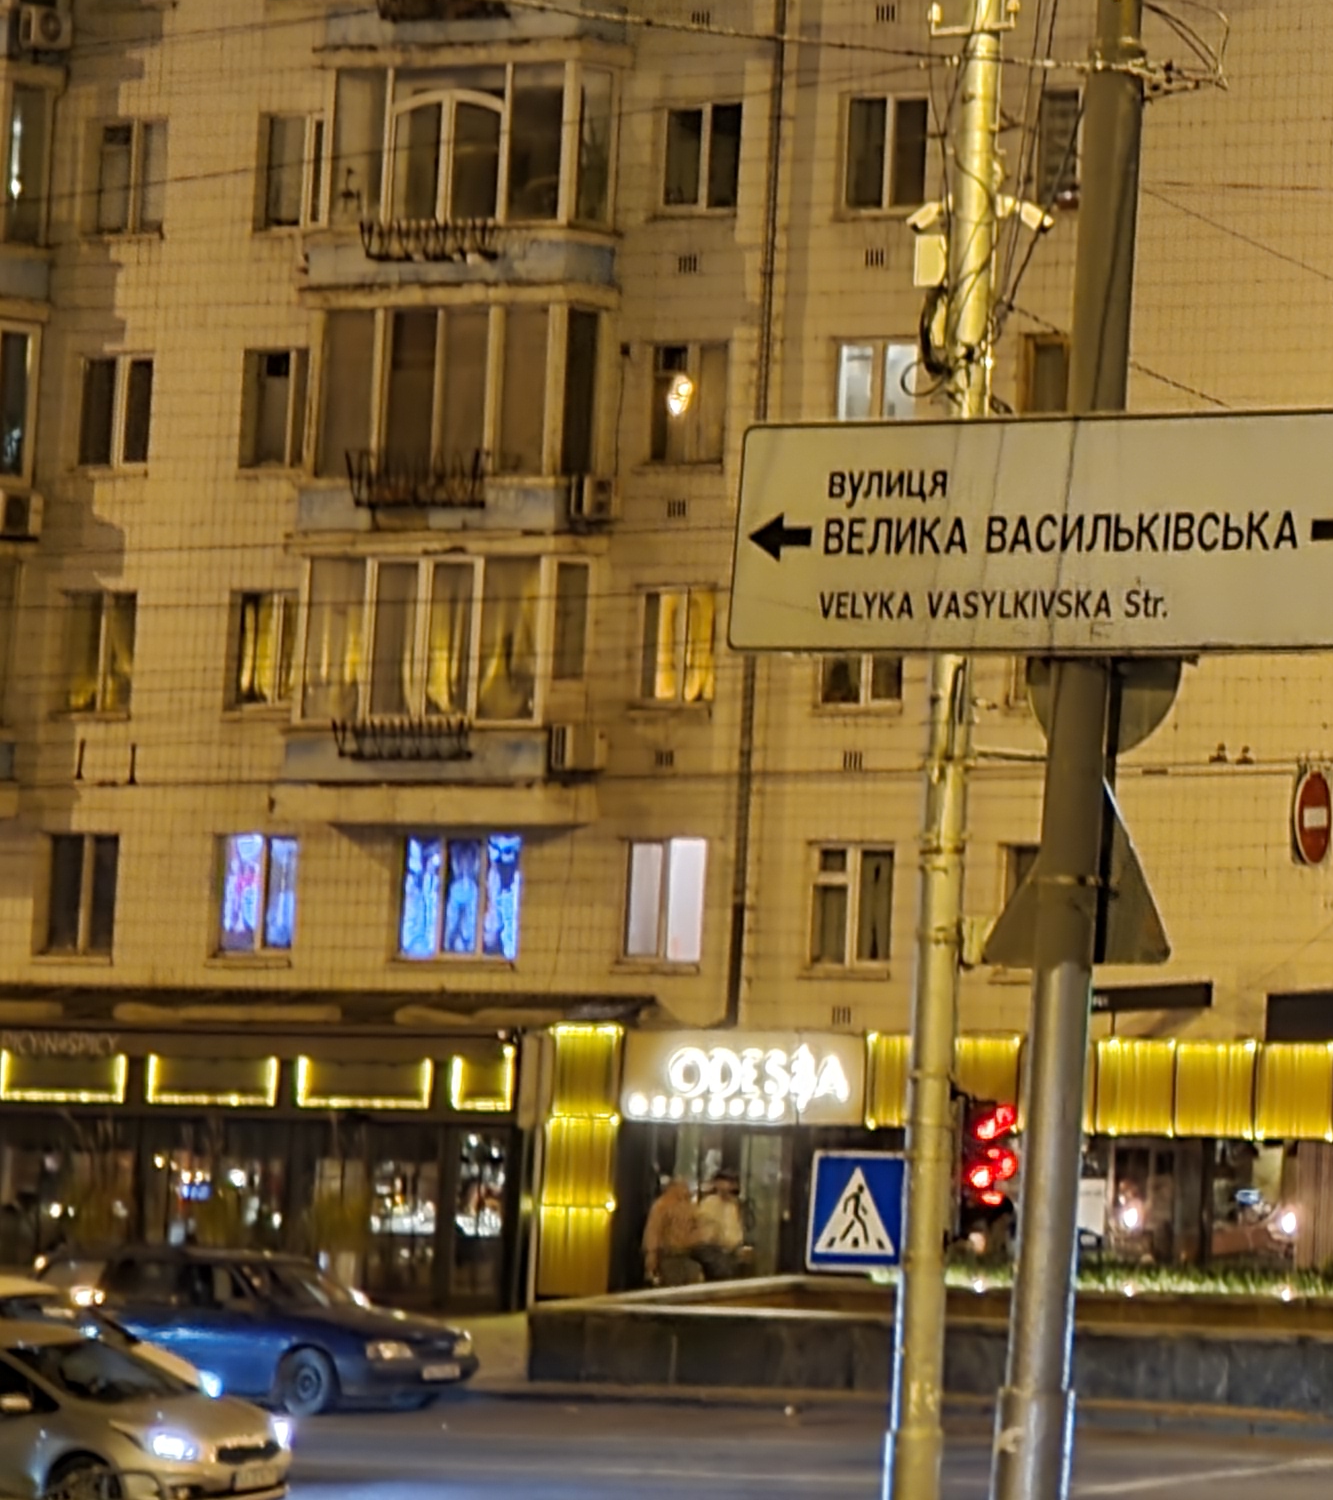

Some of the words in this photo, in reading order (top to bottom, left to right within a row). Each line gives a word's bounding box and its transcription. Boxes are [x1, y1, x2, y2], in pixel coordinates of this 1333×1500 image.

[828, 469, 948, 508] вулиця
[823, 515, 967, 555] ВЕЛИКА
[984, 510, 1298, 553] ВАСИЛЬКІВСЬКА
[819, 591, 913, 619] VELYKA
[927, 589, 1112, 619] VASYLKIVSKA
[1124, 588, 1169, 618] Str.
